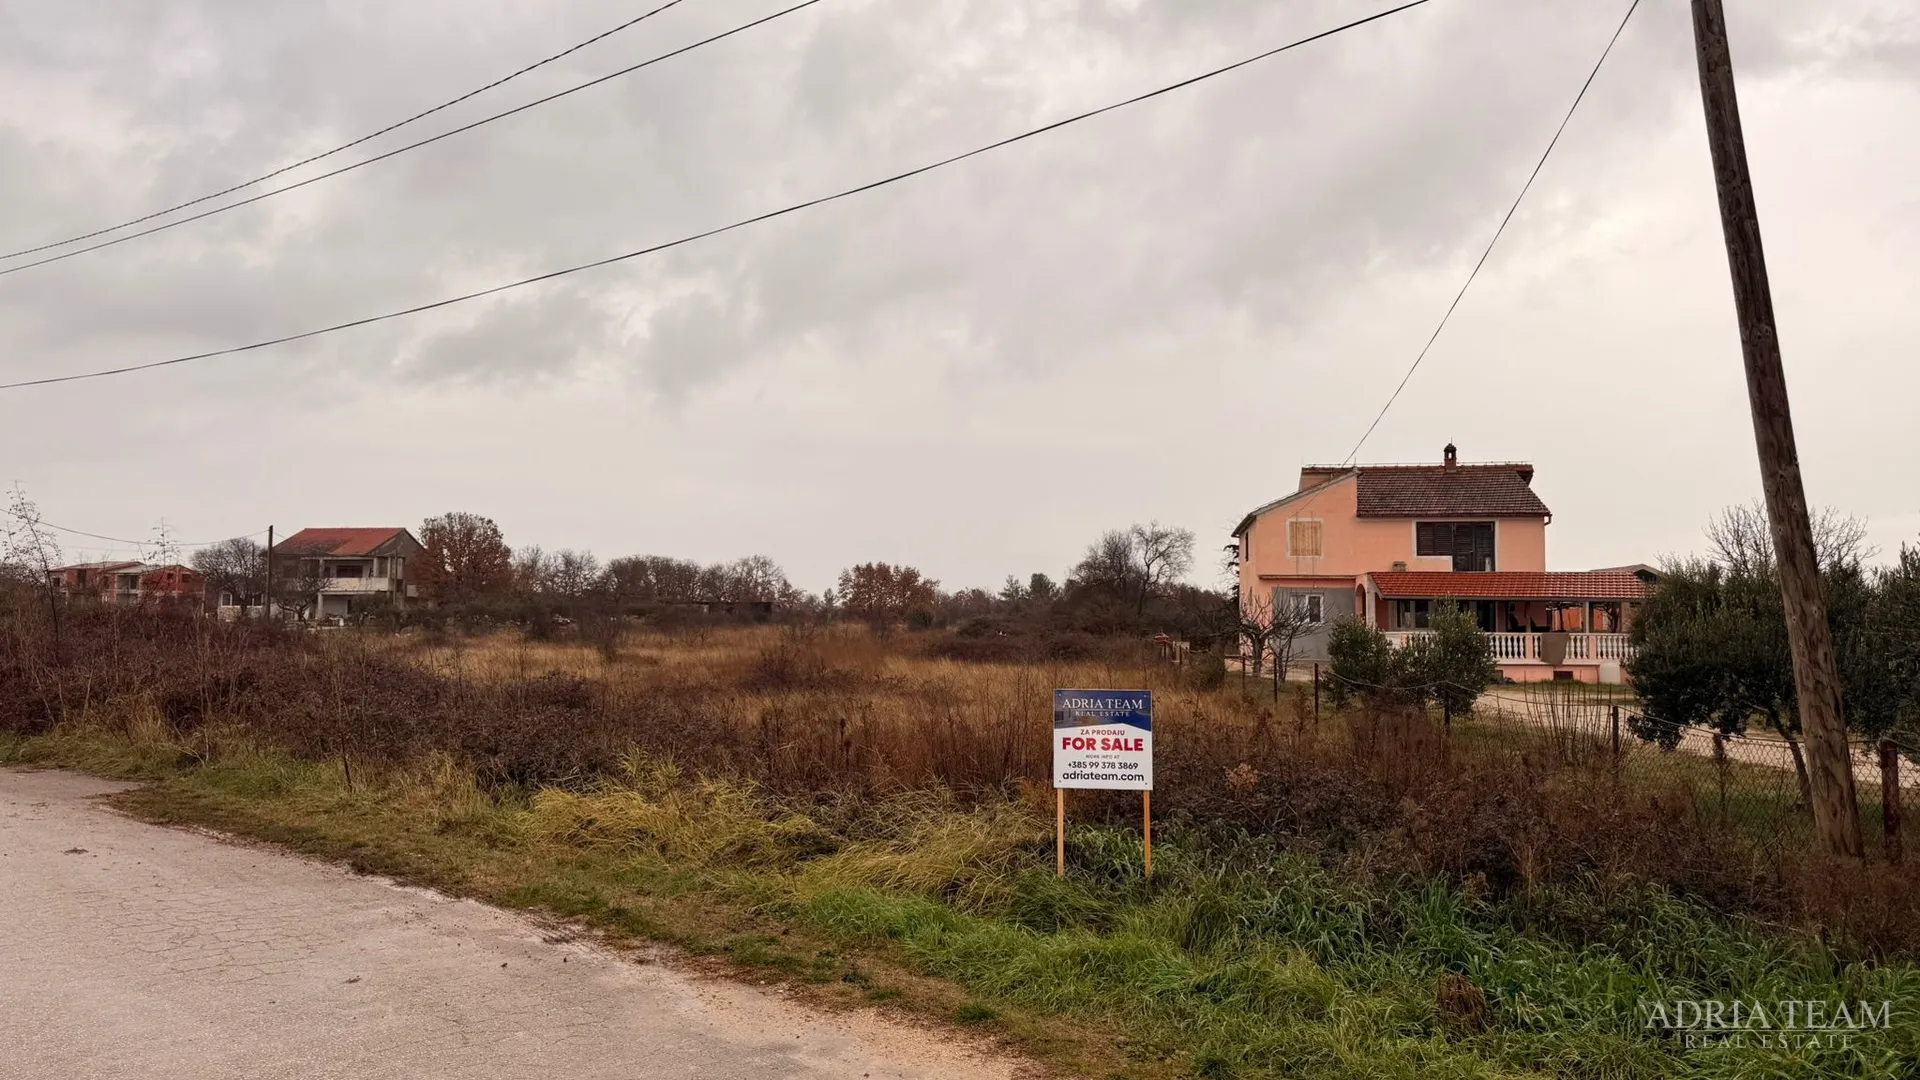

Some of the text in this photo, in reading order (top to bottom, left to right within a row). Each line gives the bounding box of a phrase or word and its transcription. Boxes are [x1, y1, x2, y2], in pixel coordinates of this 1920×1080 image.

[1062, 698, 1143, 710] ADRIA TEAM
[1062, 737, 1144, 751] FOR SALE
[1068, 761, 1087, 769] +385
[1088, 761, 1099, 769] 99
[1117, 762, 1139, 770] 3869
[1062, 770, 1145, 781] adriateam.com
